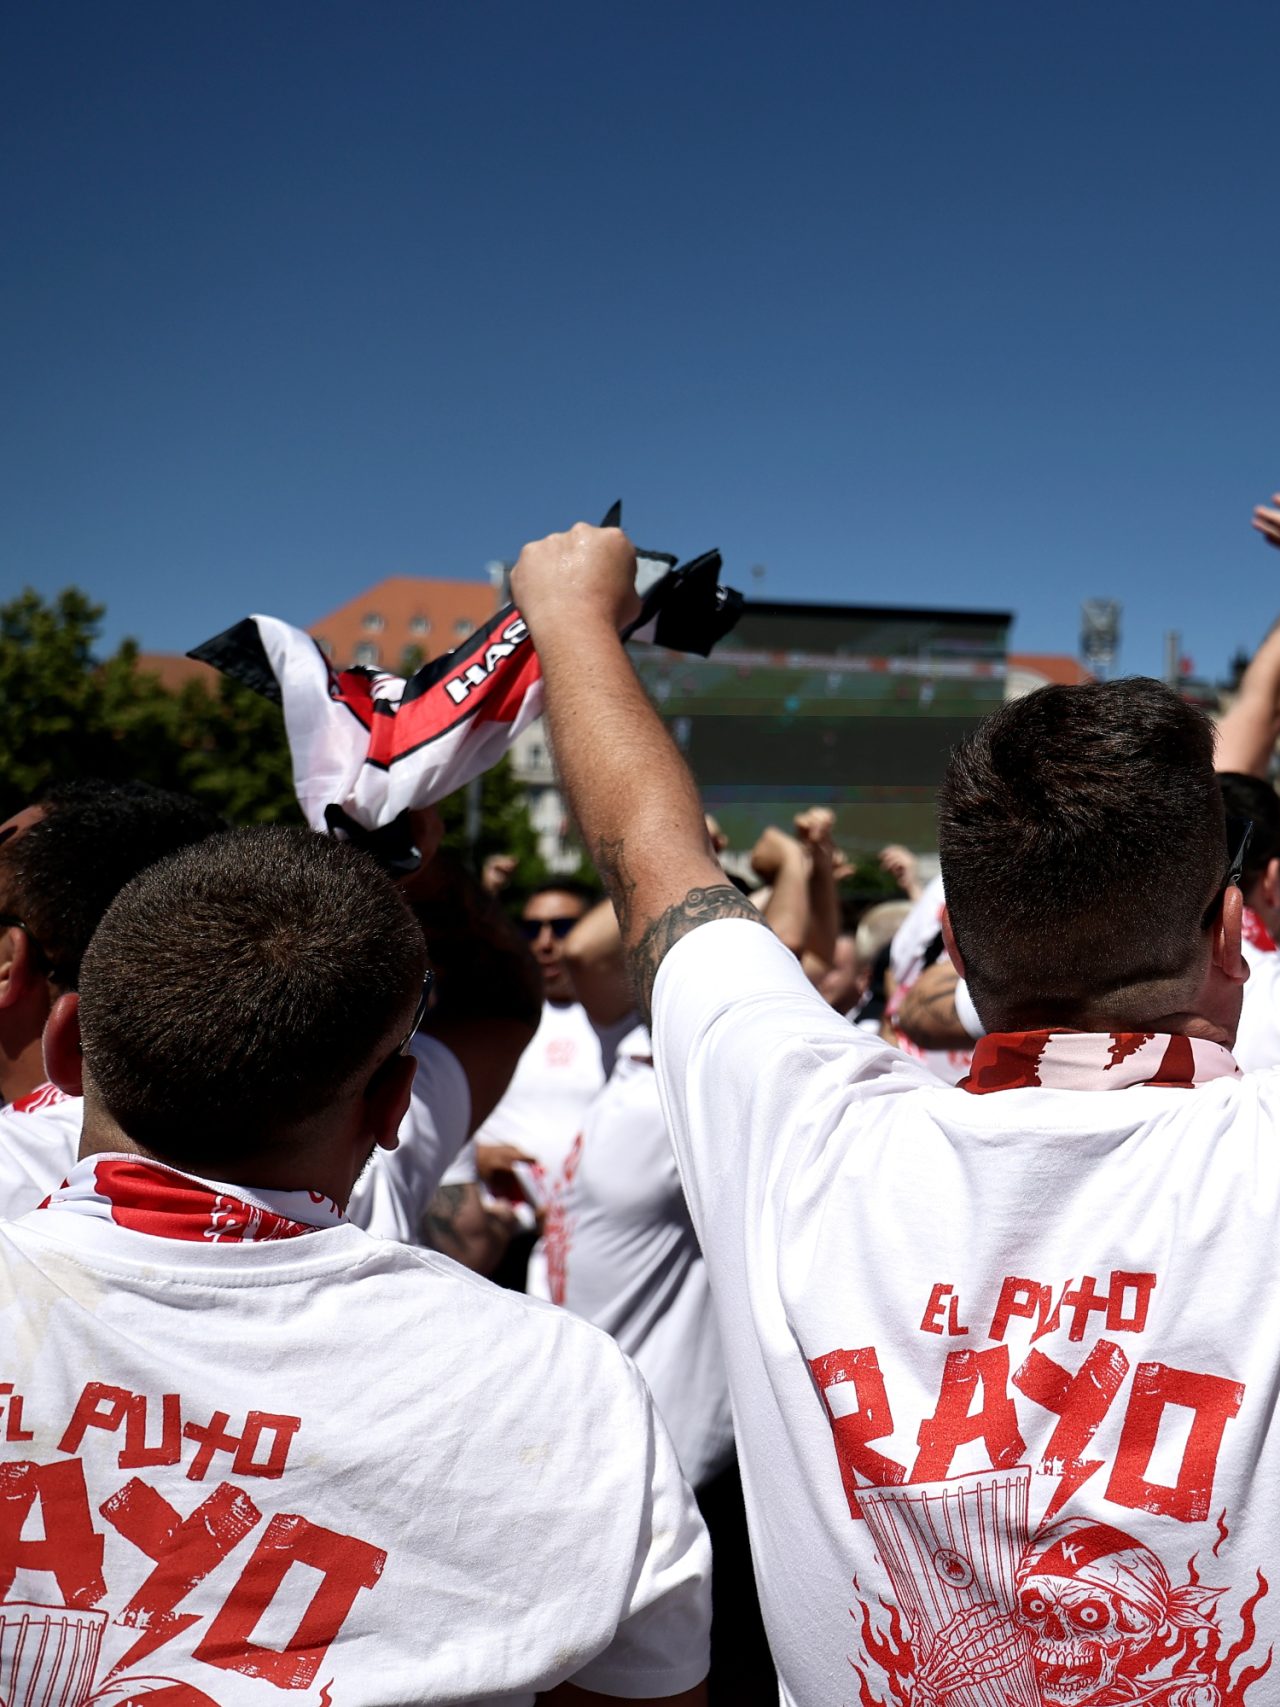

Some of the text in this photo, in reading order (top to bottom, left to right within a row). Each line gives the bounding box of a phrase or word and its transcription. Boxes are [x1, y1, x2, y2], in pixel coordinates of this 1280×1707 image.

[920, 1269, 1157, 1345] EL PUTO
[0, 1381, 301, 1482] L PUTO
[807, 1337, 1247, 1536] RAYO
